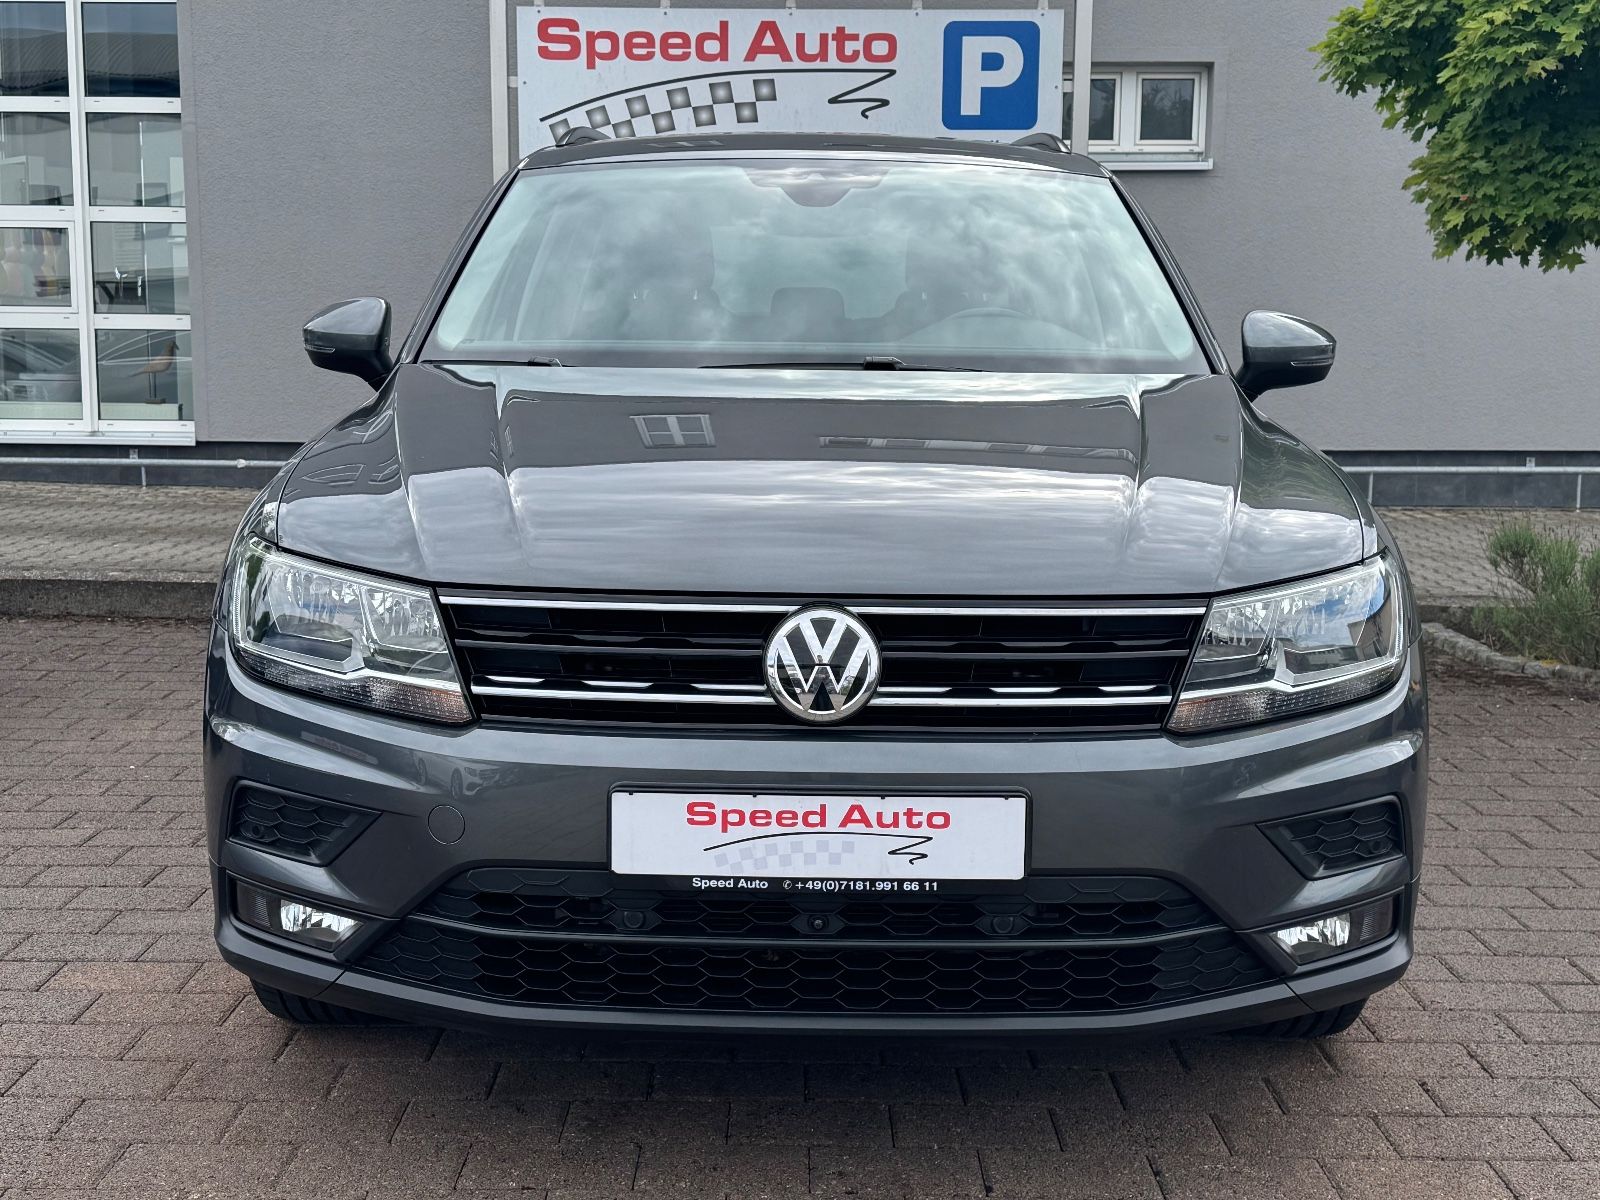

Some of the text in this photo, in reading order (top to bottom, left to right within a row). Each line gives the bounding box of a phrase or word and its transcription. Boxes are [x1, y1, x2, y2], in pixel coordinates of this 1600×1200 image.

[538, 17, 898, 70] Speed Auto
[960, 36, 1024, 116] P
[766, 608, 880, 722] VW
[686, 801, 951, 833] Speed Auto
[692, 877, 938, 892] Speed Auto +49(0)7181.991 66 11
